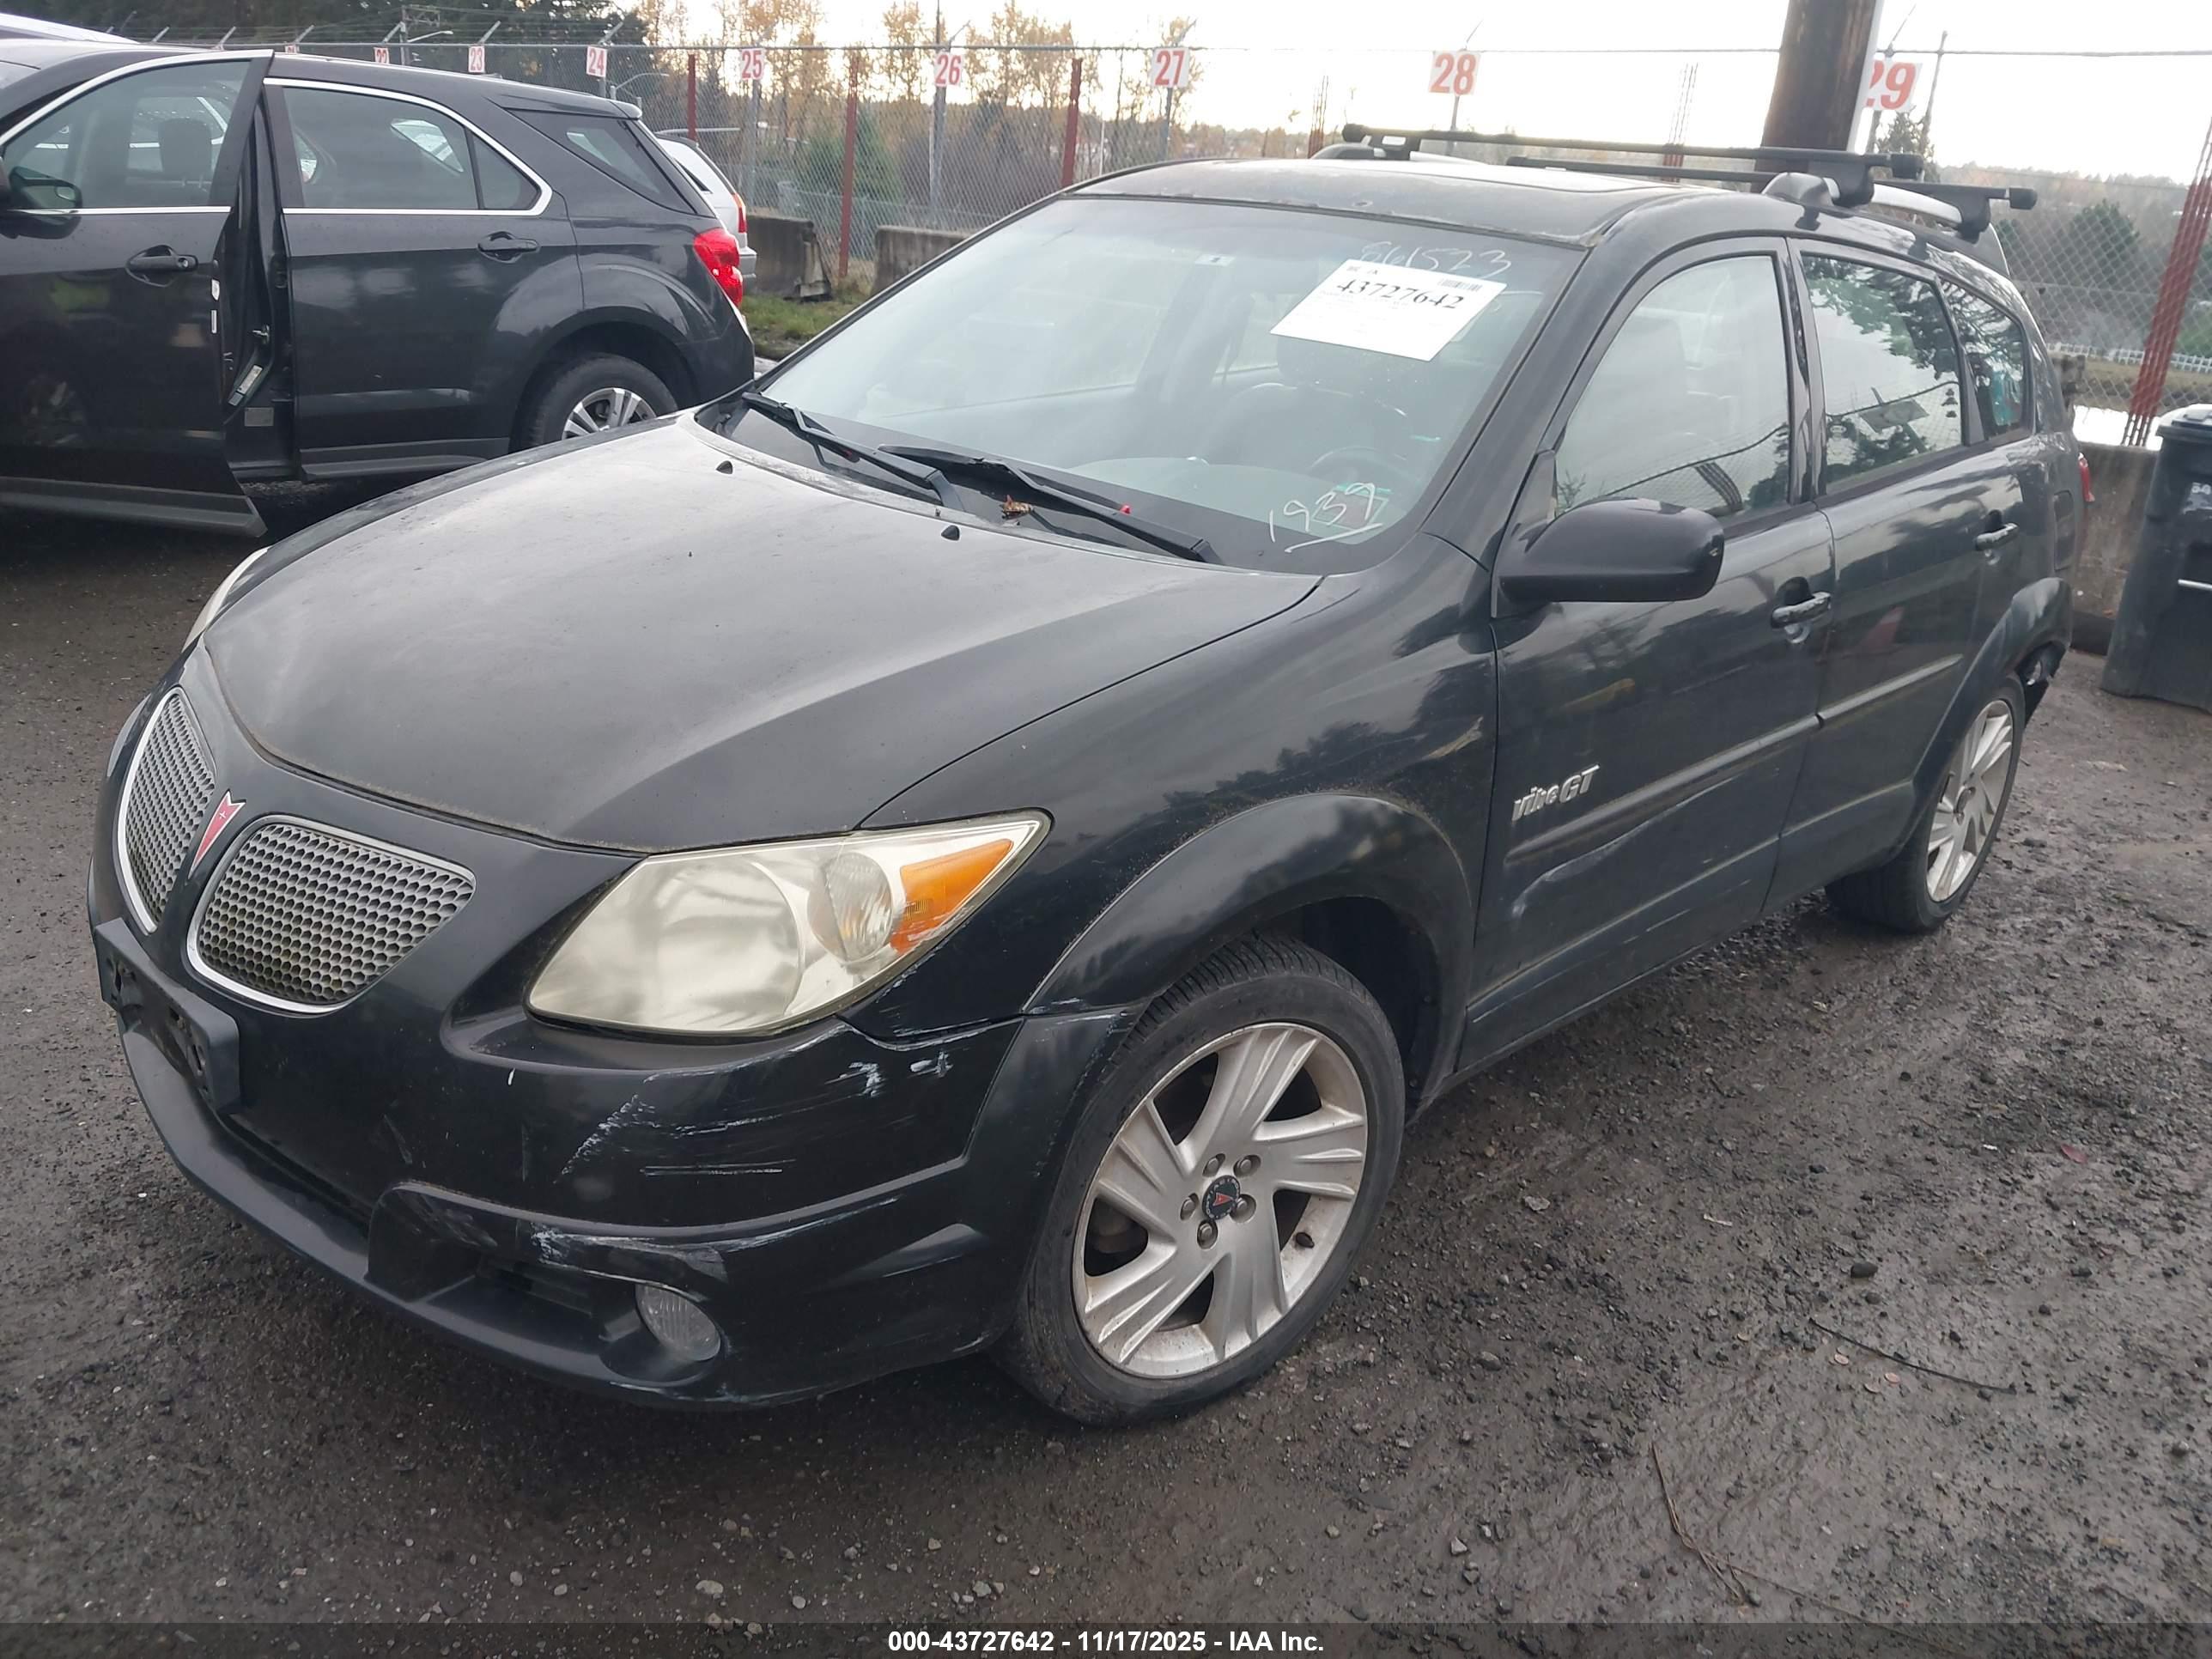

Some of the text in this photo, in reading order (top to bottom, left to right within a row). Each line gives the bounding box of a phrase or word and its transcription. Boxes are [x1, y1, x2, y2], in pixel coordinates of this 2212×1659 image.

[470, 47, 482, 70] 23
[588, 47, 605, 76] 24
[742, 50, 762, 78] 25
[935, 54, 961, 85] 26
[1154, 50, 1185, 85] 27
[1430, 53, 1476, 95] 28
[1336, 279, 1464, 309] 43727642
[1559, 764, 1600, 803] GT
